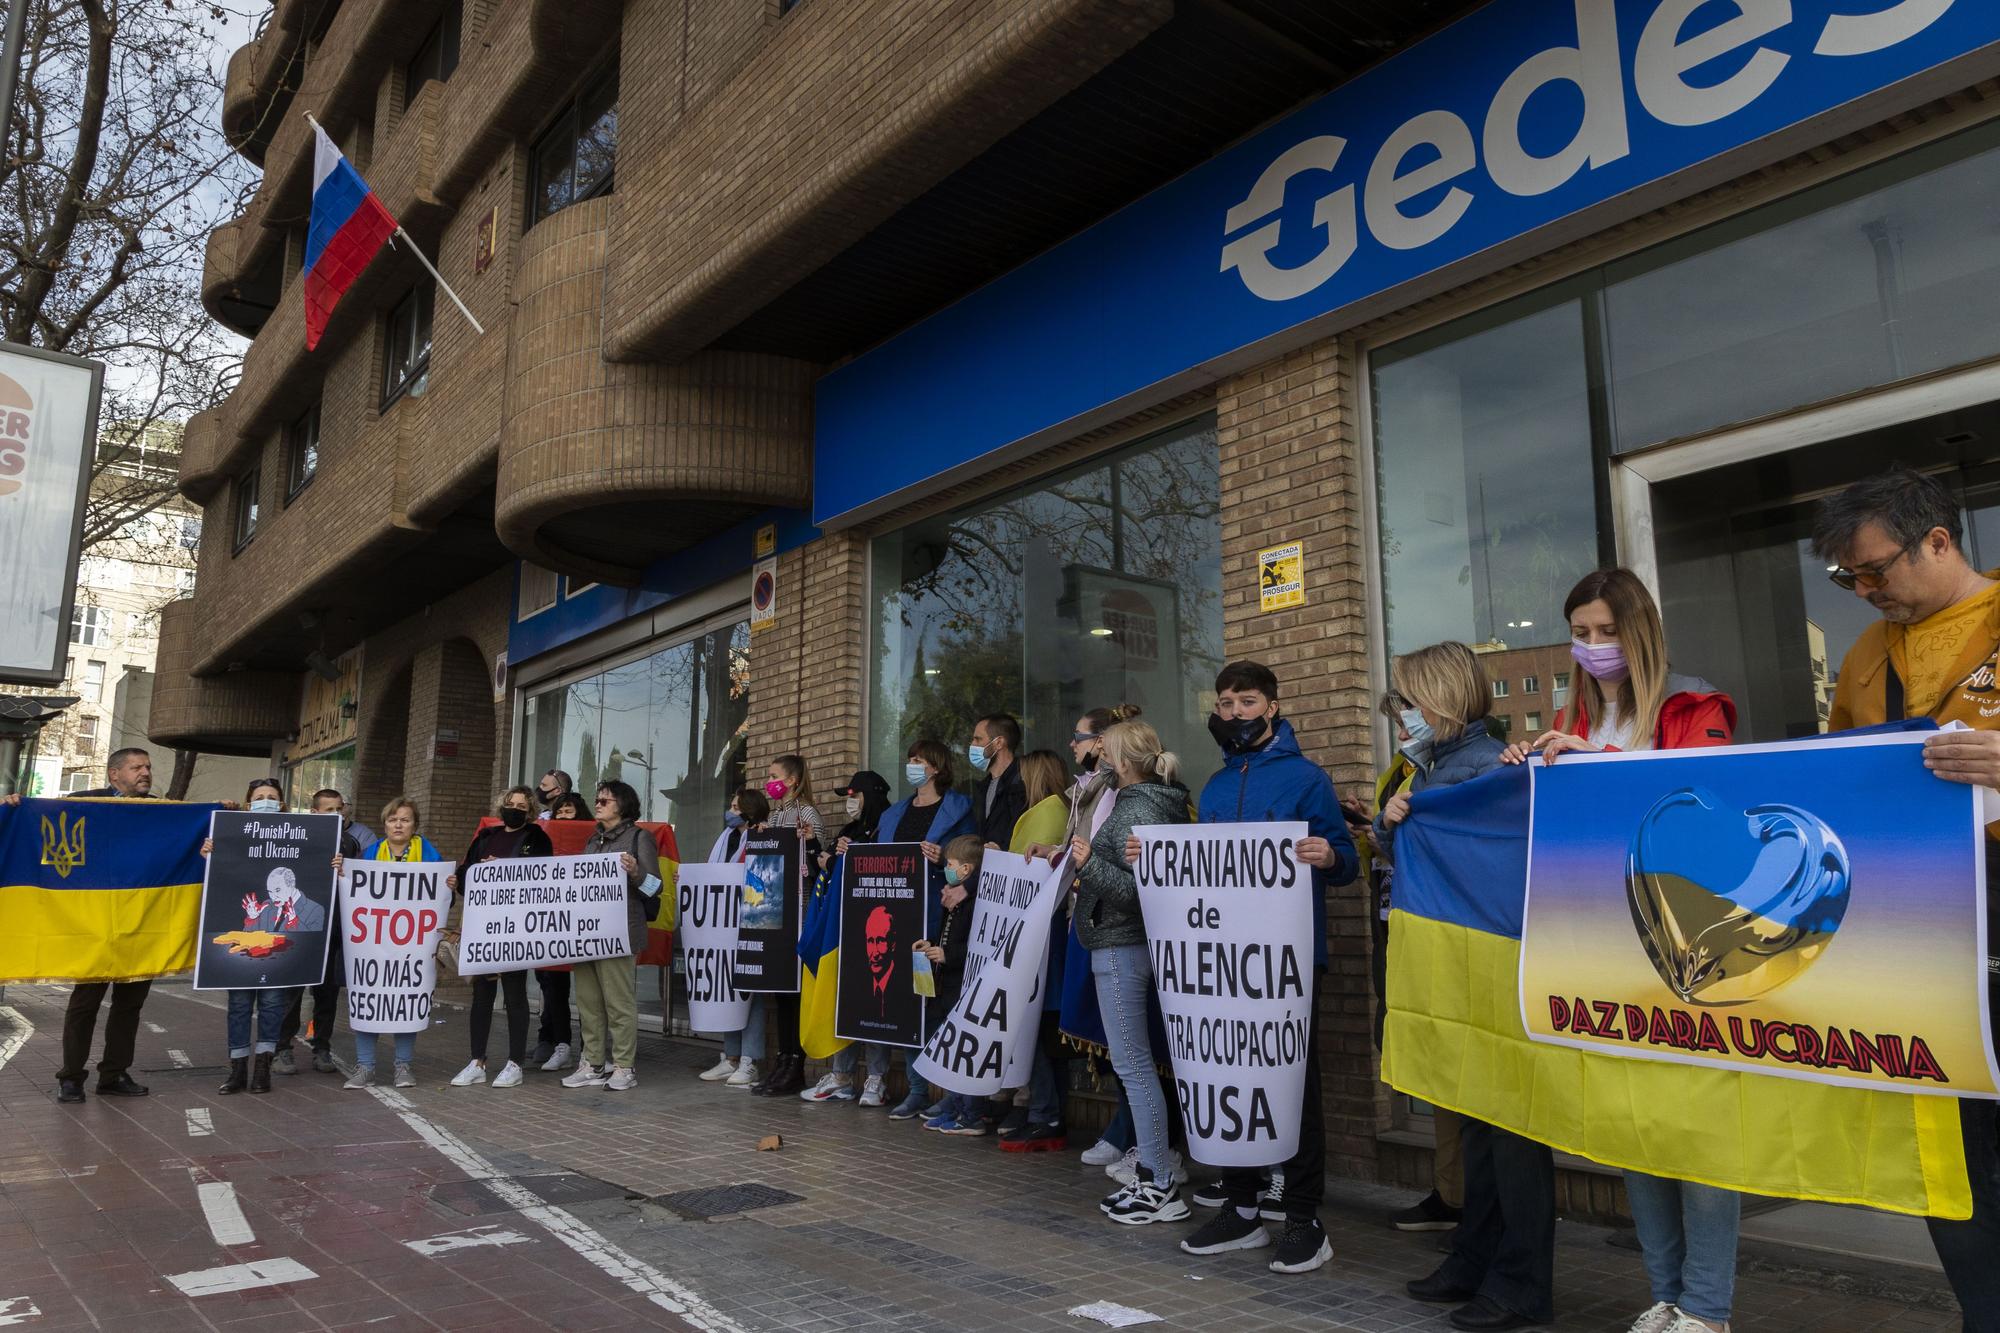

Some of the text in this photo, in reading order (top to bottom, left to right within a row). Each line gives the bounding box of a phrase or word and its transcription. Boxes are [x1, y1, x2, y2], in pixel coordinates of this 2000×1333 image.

[1261, 546, 1298, 560] CONECTADA
[1262, 582, 1300, 597] PROSEGUR
[1963, 693, 1976, 702] WE
[248, 842, 300, 859] not Ukraine
[853, 856, 916, 874] TERRORIST #1
[1139, 837, 1297, 889] UCRANIANOS
[350, 869, 438, 900] PUTIN
[474, 858, 618, 883] UCRANIANOS de ESPAÑA
[876, 877, 884, 887] AND
[884, 877, 893, 887] KILL
[468, 884, 623, 906] POR LIBRE ENTRADA de UCRANIA
[350, 907, 438, 945] STOP
[486, 910, 600, 936] en la OTAN por
[1187, 899, 1221, 929] de
[977, 912, 988, 943] A
[991, 915, 1008, 948] LA
[467, 937, 625, 963] SEGURIDAD COLECTIVA
[353, 954, 423, 988] NO MÁS
[687, 947, 751, 1003] SESIN
[1150, 939, 1304, 1000] VALENCIA
[1200, 1010, 1307, 1067] OCUPACIÓN
[1548, 995, 1950, 1083] PAZ PARA UCRANIA
[1179, 1078, 1278, 1142] RUSA
